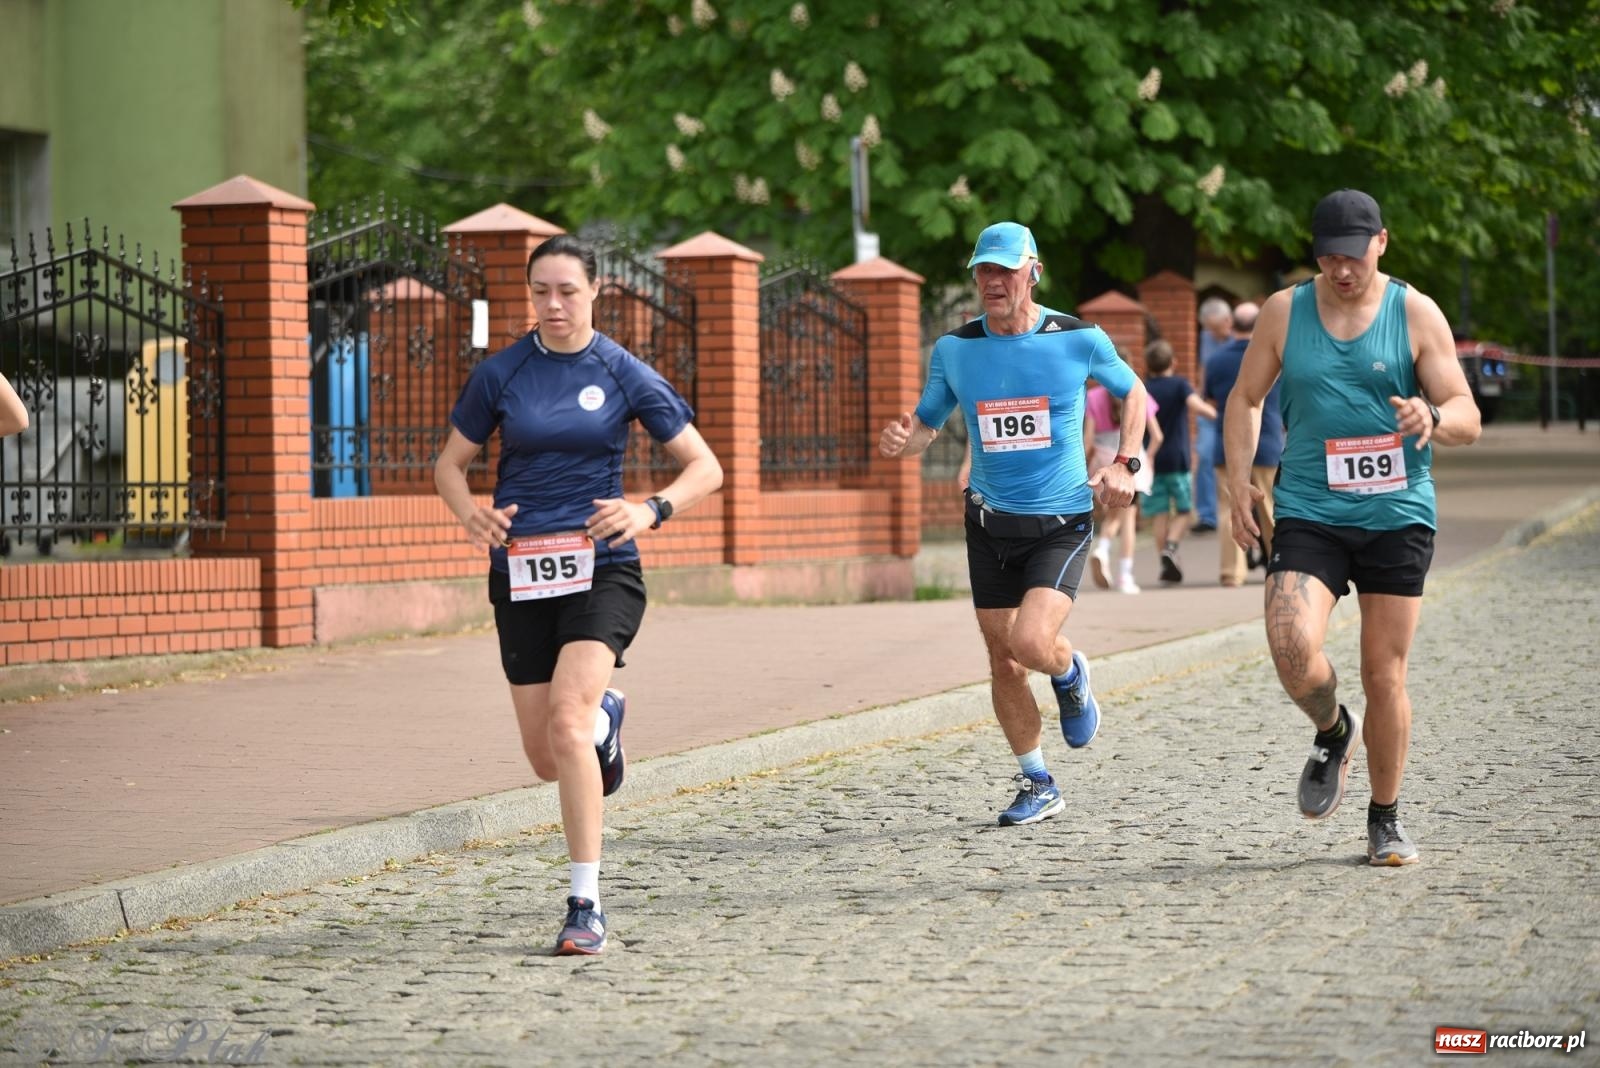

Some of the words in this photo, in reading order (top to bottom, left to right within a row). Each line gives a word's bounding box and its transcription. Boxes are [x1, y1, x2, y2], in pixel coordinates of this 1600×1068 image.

[992, 414, 1036, 438] 196
[1344, 454, 1392, 480] 169
[526, 555, 578, 582] 195
